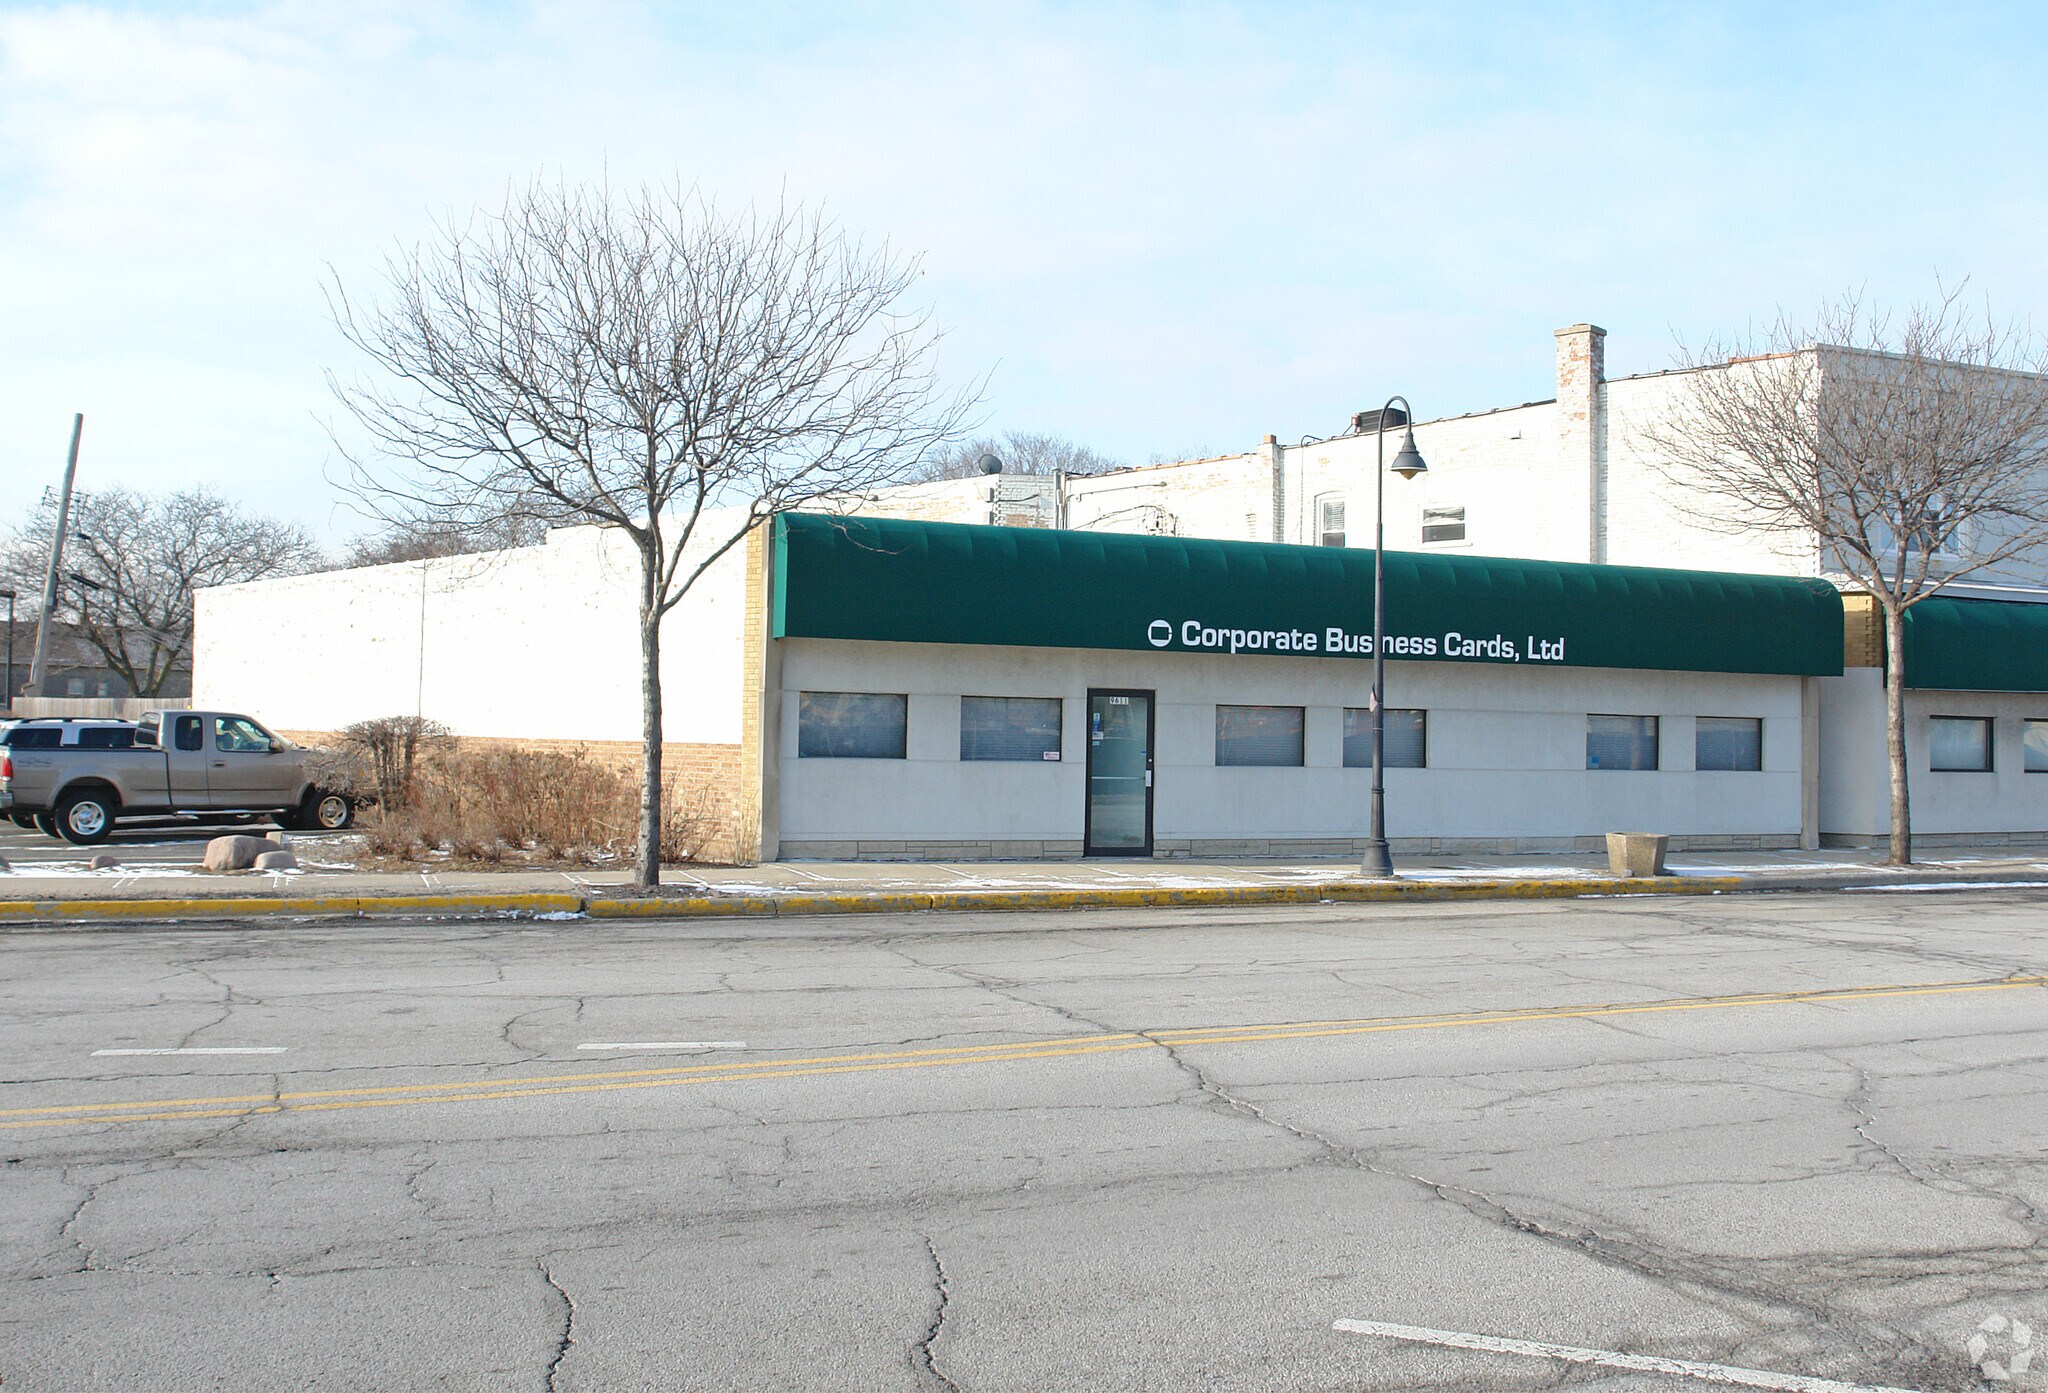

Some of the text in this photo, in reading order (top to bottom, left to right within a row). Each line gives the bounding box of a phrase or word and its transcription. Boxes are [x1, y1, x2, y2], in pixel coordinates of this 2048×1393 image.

[1181, 620, 1565, 662] Corporate Busness Cards, Ltd
[1110, 696, 1128, 704] 9611
